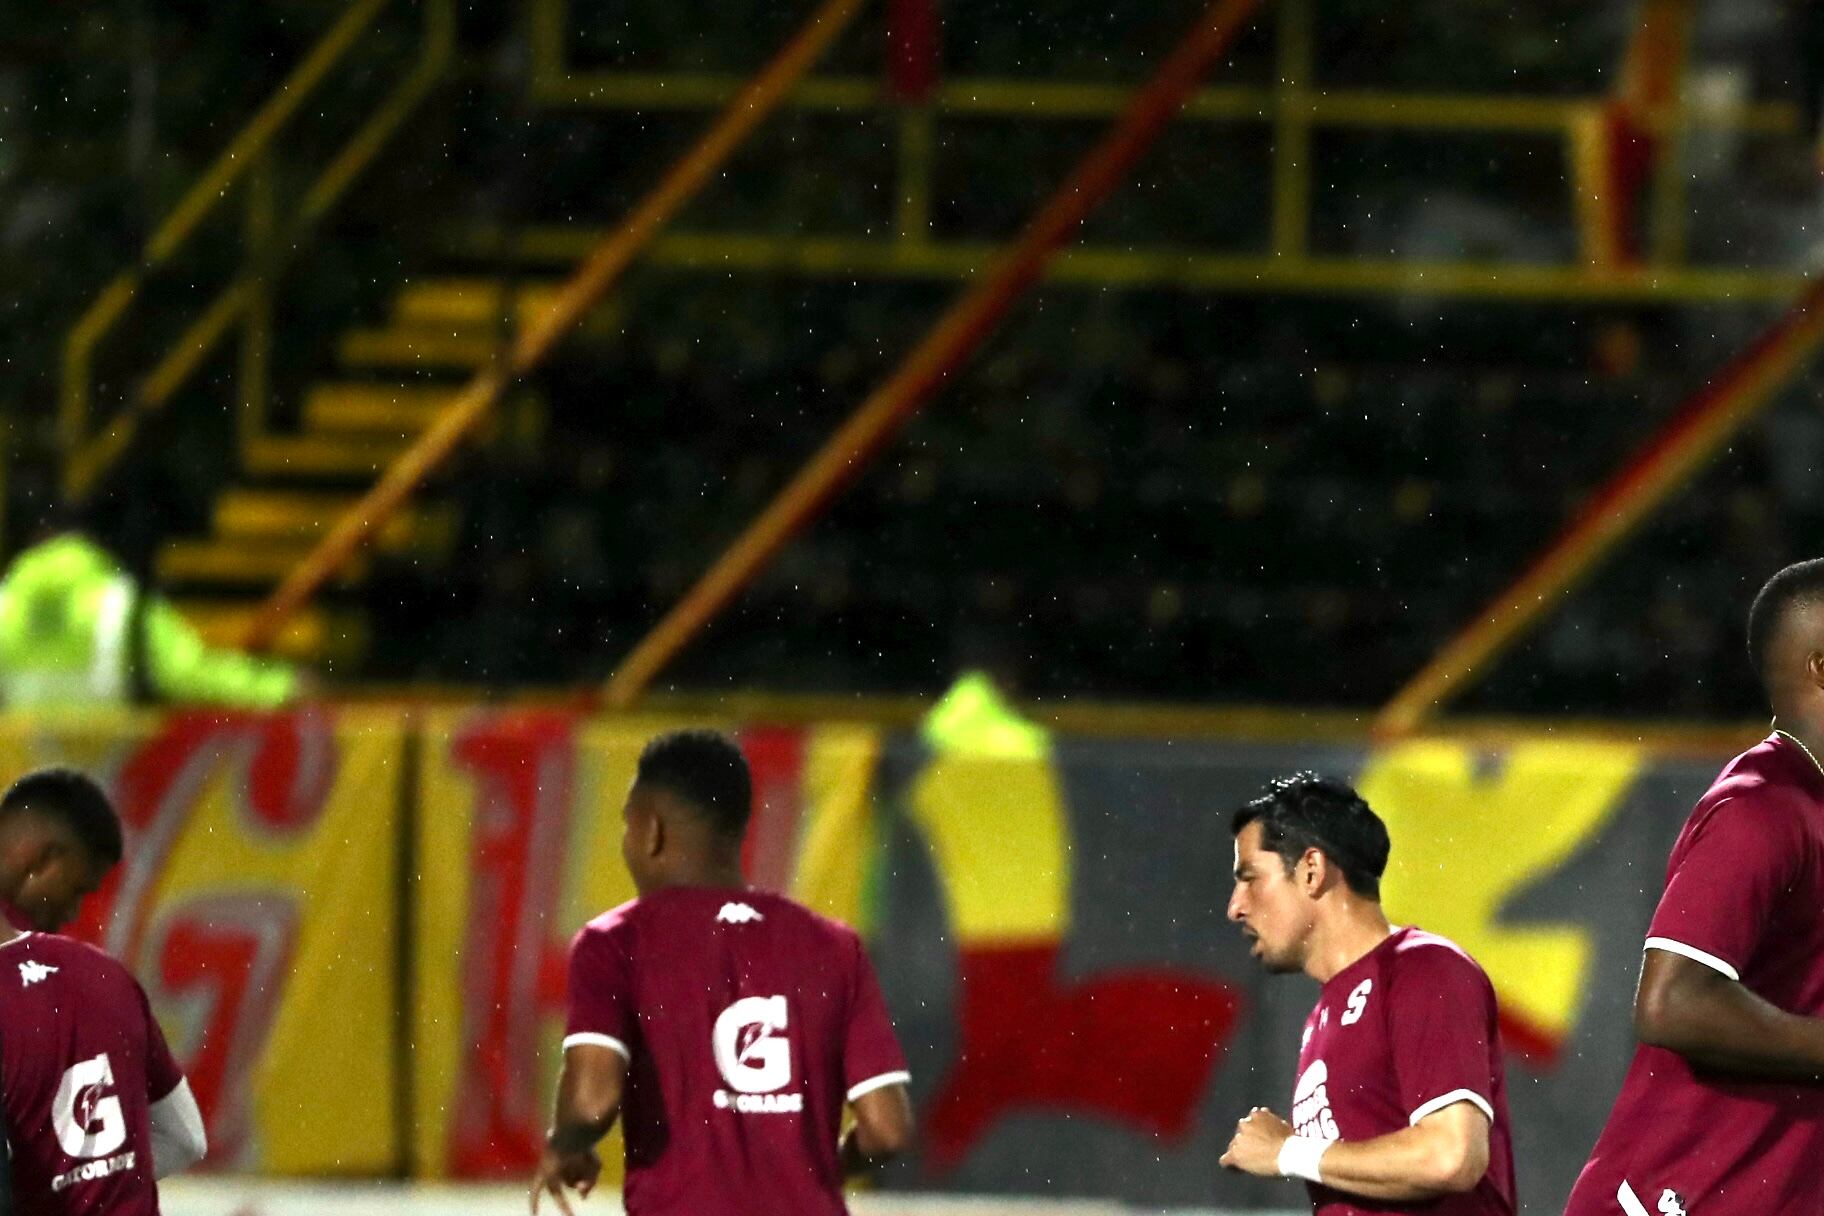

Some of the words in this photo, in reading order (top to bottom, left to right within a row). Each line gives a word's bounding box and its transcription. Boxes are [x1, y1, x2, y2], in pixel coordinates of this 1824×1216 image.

[711, 995, 791, 1093] G
[1341, 978, 1373, 1026] S
[52, 1052, 127, 1158] G
